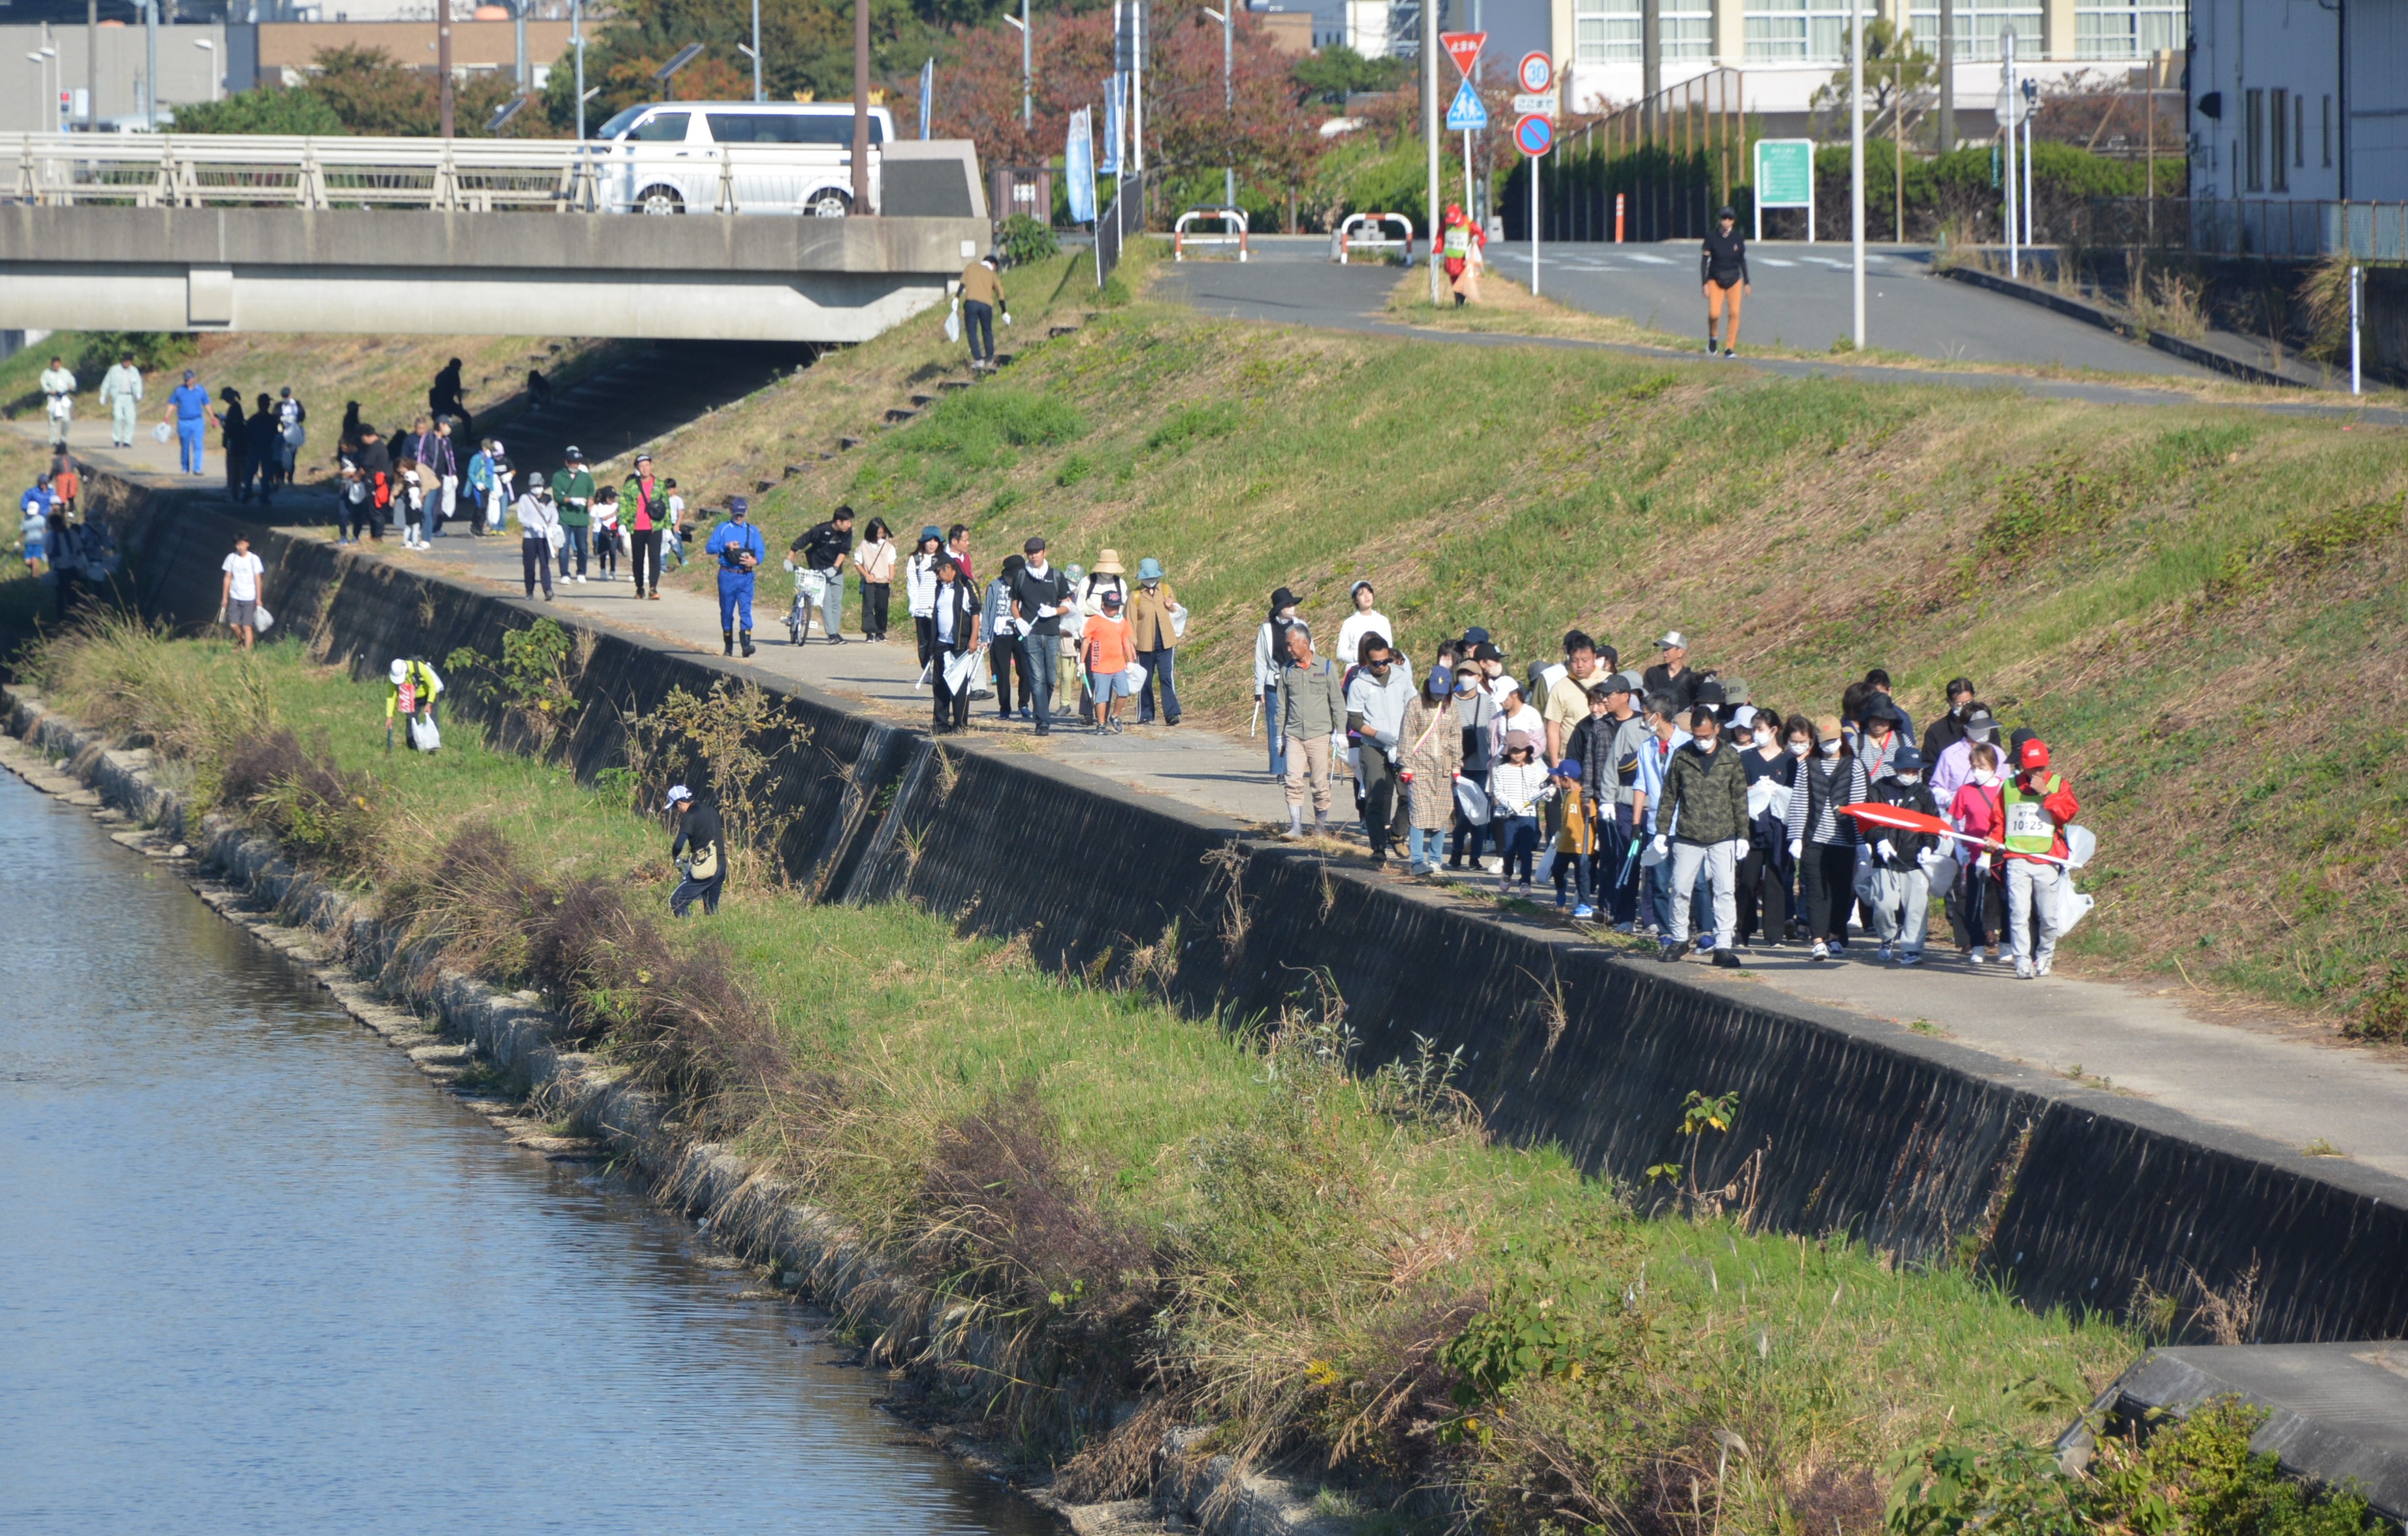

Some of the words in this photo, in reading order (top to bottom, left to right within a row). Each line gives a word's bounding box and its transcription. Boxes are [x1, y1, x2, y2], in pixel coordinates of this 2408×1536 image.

[1451, 40, 1478, 51] 止まれ
[1527, 64, 1547, 83] 30
[2013, 820, 2043, 831] 10:25
